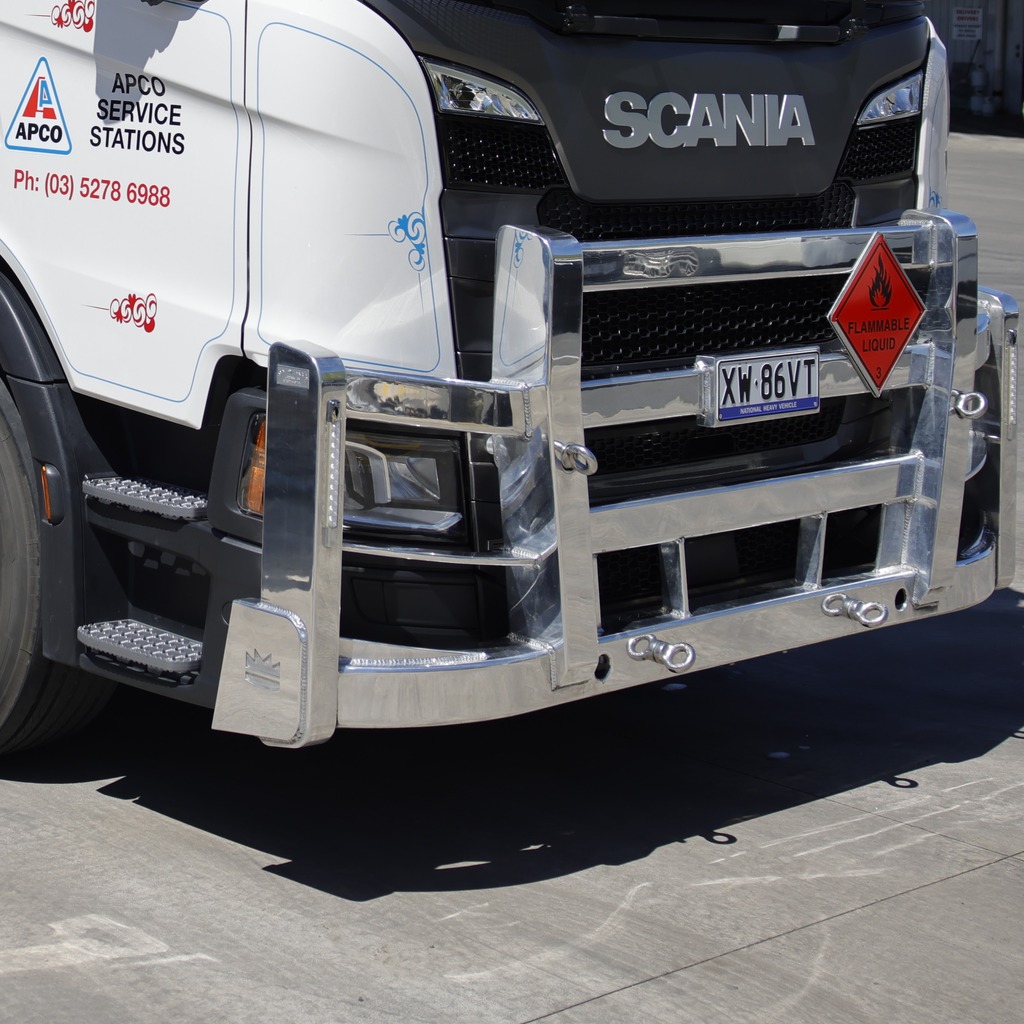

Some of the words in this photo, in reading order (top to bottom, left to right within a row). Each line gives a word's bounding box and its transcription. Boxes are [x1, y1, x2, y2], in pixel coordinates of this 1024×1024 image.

[112, 73, 166, 97] APCO
[96, 98, 182, 126] SERVICE
[602, 91, 816, 149] SCANIA
[15, 122, 63, 143] APCO
[89, 126, 185, 155] STATIONS
[14, 169, 39, 192] Ph:
[45, 172, 74, 201] (03)
[80, 177, 121, 202] 5278
[127, 182, 171, 207] 6988
[848, 317, 910, 334] FLAMMABLE
[862, 337, 896, 352] LIQUID
[876, 367, 882, 379] 3
[740, 406, 762, 414] NATIONAL
[763, 404, 778, 412] HEAVY
[778, 401, 797, 409] VEHICLE
